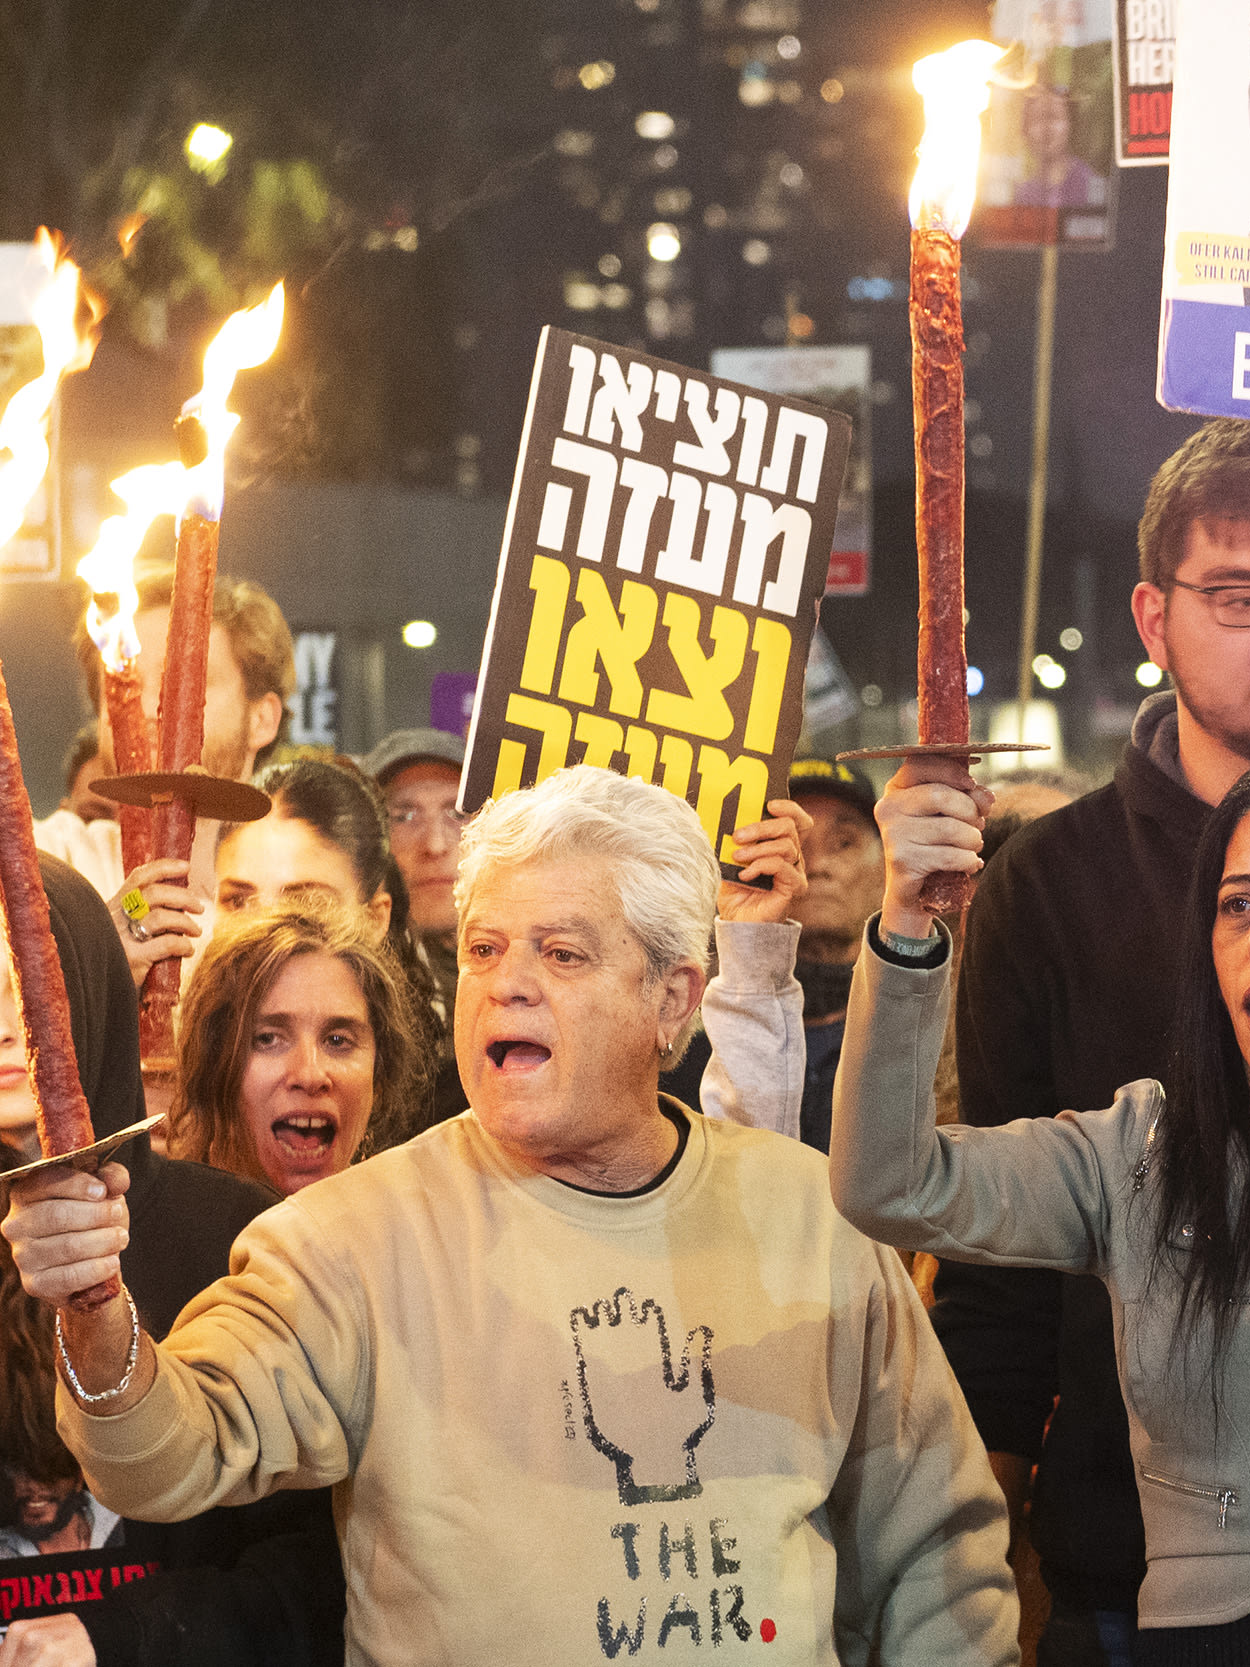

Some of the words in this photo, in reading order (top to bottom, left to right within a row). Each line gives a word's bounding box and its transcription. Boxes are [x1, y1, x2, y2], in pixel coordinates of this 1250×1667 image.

[1126, 0, 1176, 40] BRI
[1129, 91, 1172, 135] HO
[1190, 242, 1220, 258] OFER
[1195, 263, 1224, 280] STILL
[563, 344, 828, 503] תוציאו
[536, 437, 812, 617] מעזה
[520, 554, 793, 755] וצאו
[611, 1517, 741, 1582] THE
[597, 1585, 777, 1660] WAR.
